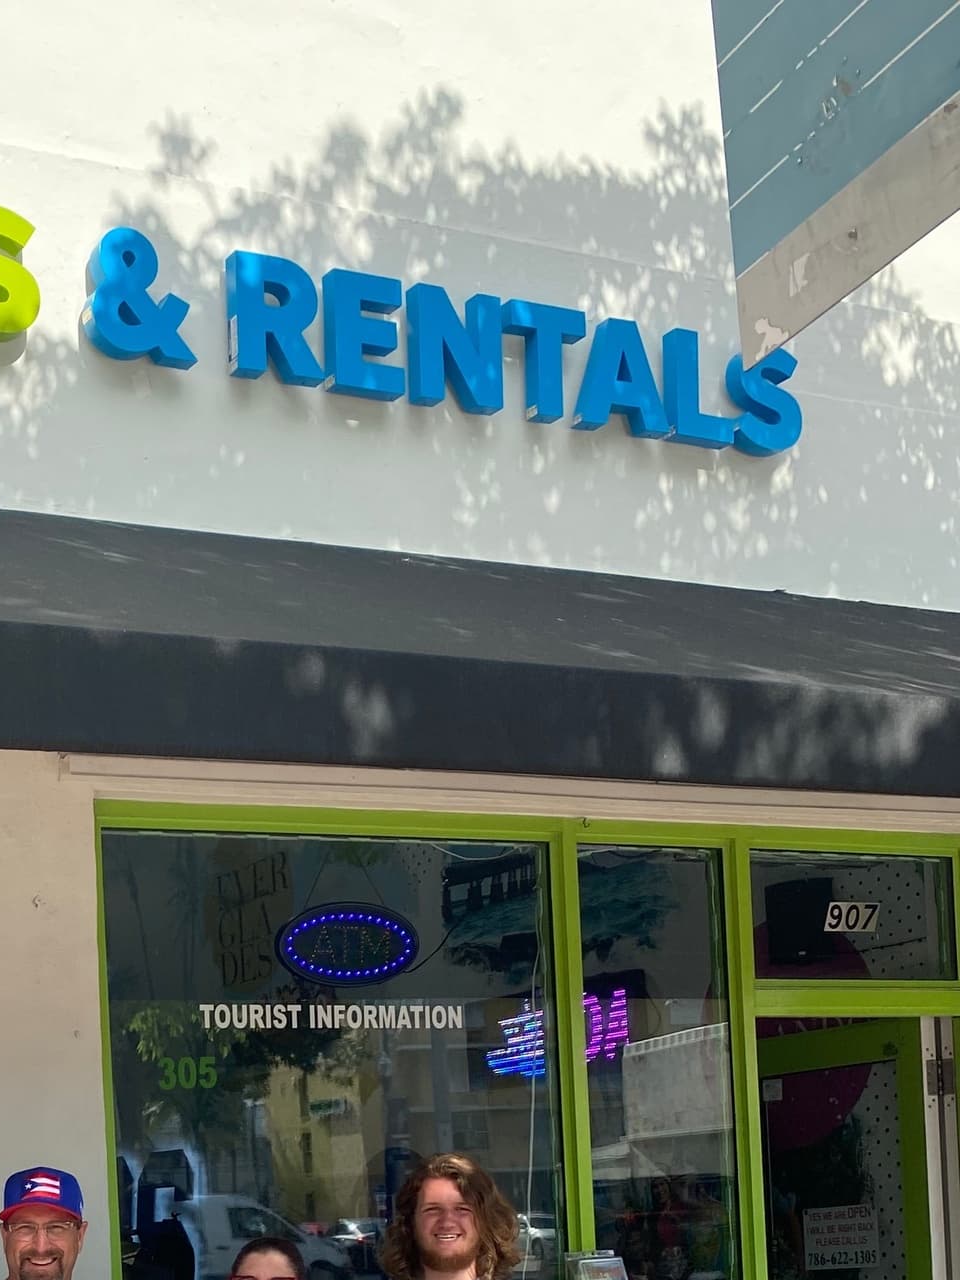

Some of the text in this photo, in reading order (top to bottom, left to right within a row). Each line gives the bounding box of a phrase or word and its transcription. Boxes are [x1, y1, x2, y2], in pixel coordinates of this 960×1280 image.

[82, 226, 198, 370] &
[225, 248, 802, 457] RENTALS
[827, 903, 878, 930] 907
[310, 925, 390, 964] ATM
[200, 1003, 463, 1030] TOURIST INFORMATION
[159, 1056, 218, 1091] 305
[848, 1206, 871, 1219] OPEN
[808, 1250, 876, 1266] 786-622-1305
